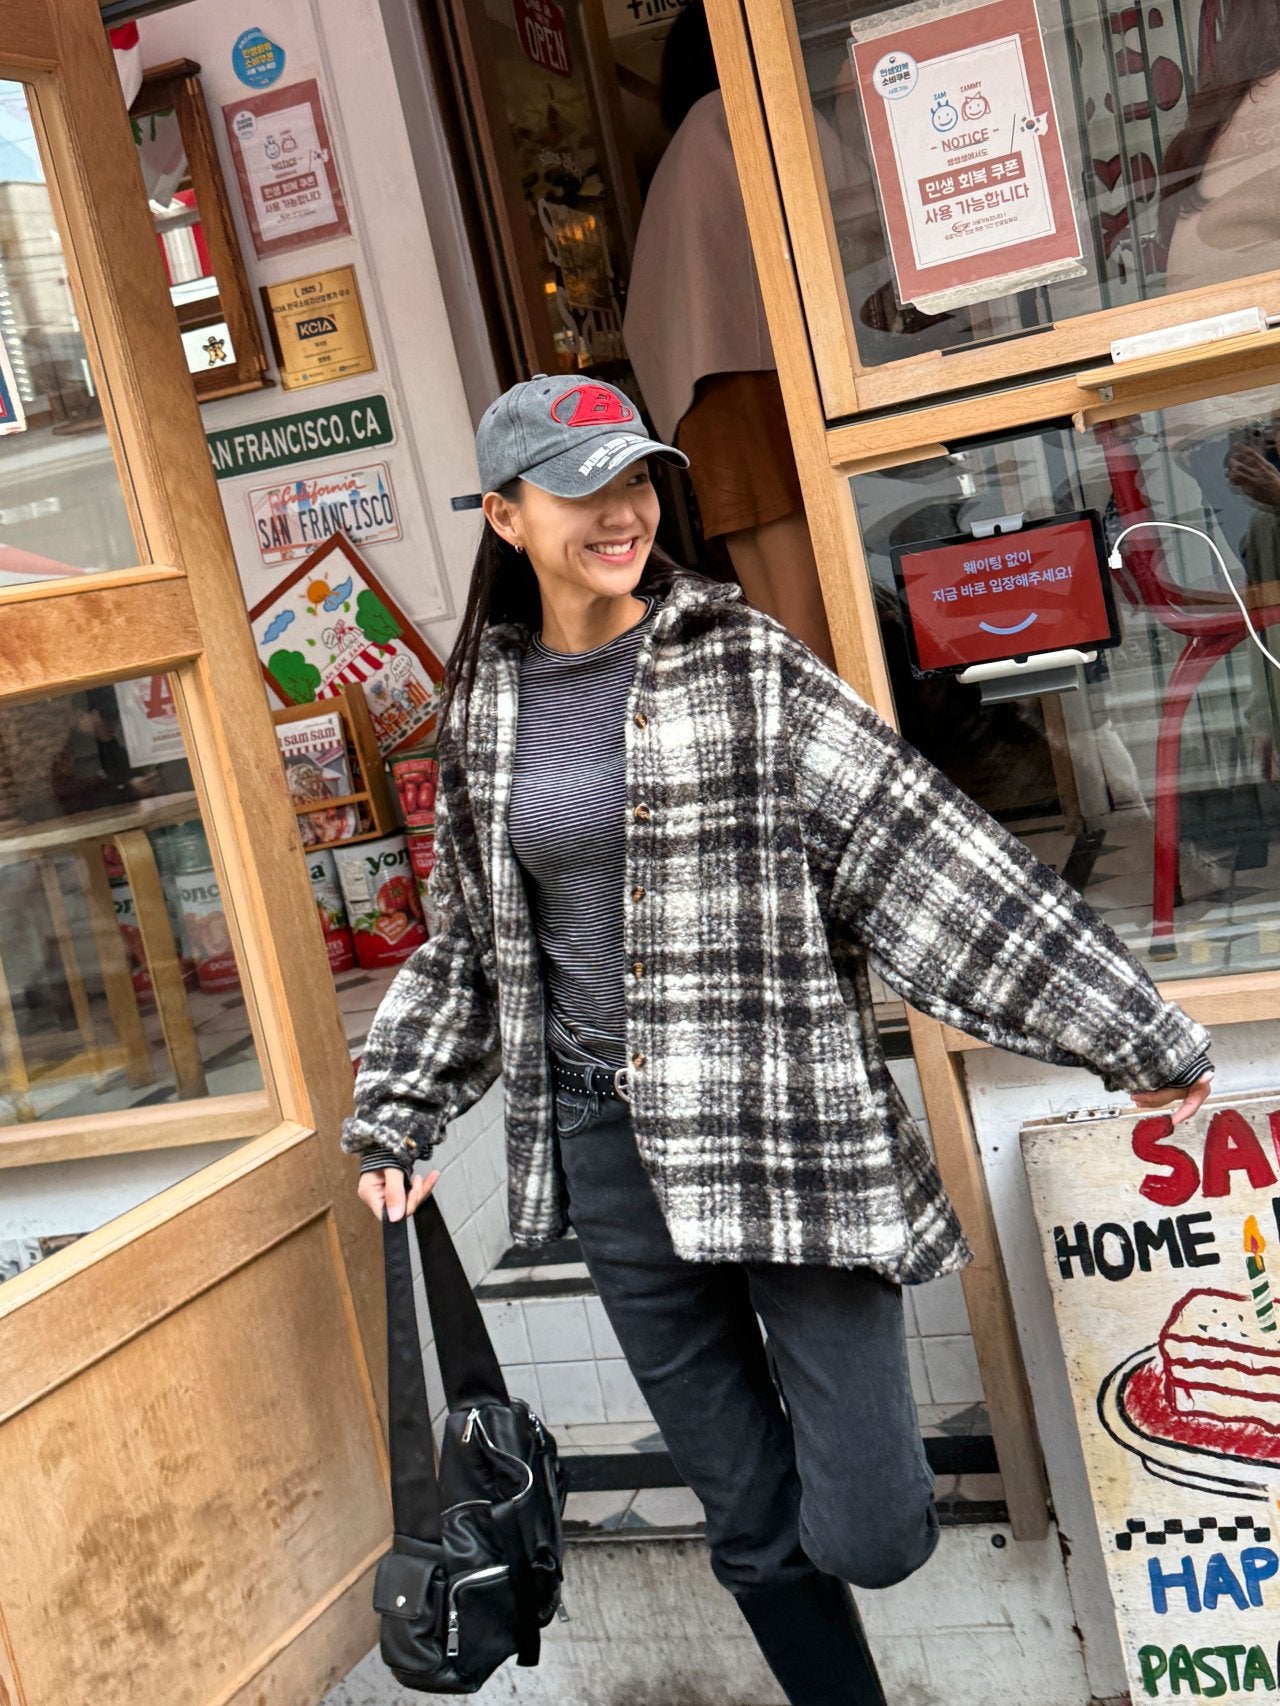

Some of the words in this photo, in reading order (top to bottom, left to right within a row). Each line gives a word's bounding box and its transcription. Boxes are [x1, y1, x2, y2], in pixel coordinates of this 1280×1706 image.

[524, 16, 570, 73] OPEN
[941, 128, 989, 151] NOTICE
[925, 178, 955, 198] 민생
[958, 168, 987, 189] 회복
[991, 159, 1020, 180] 쿠폰
[925, 204, 953, 224] 사용
[955, 182, 1030, 215] 가능합니다
[300, 320, 333, 338] KCIA
[233, 415, 350, 466] FRANCISCO,
[351, 407, 382, 440] CA
[281, 477, 367, 507] California
[258, 513, 292, 549] SAN
[299, 493, 395, 542] FRANCISCO
[963, 554, 1003, 576] 웨이팅
[1005, 549, 1033, 566] 없이
[932, 586, 959, 603] 지금
[961, 581, 988, 599] 바로
[989, 566, 1073, 594] 입장해주세요!
[284, 731, 309, 747] sam
[310, 727, 336, 742] sam
[1132, 1109, 1280, 1207] SA
[1053, 1211, 1220, 1282] HOME
[1148, 1547, 1279, 1614] HAP
[1138, 1644, 1276, 1698] PASTA
